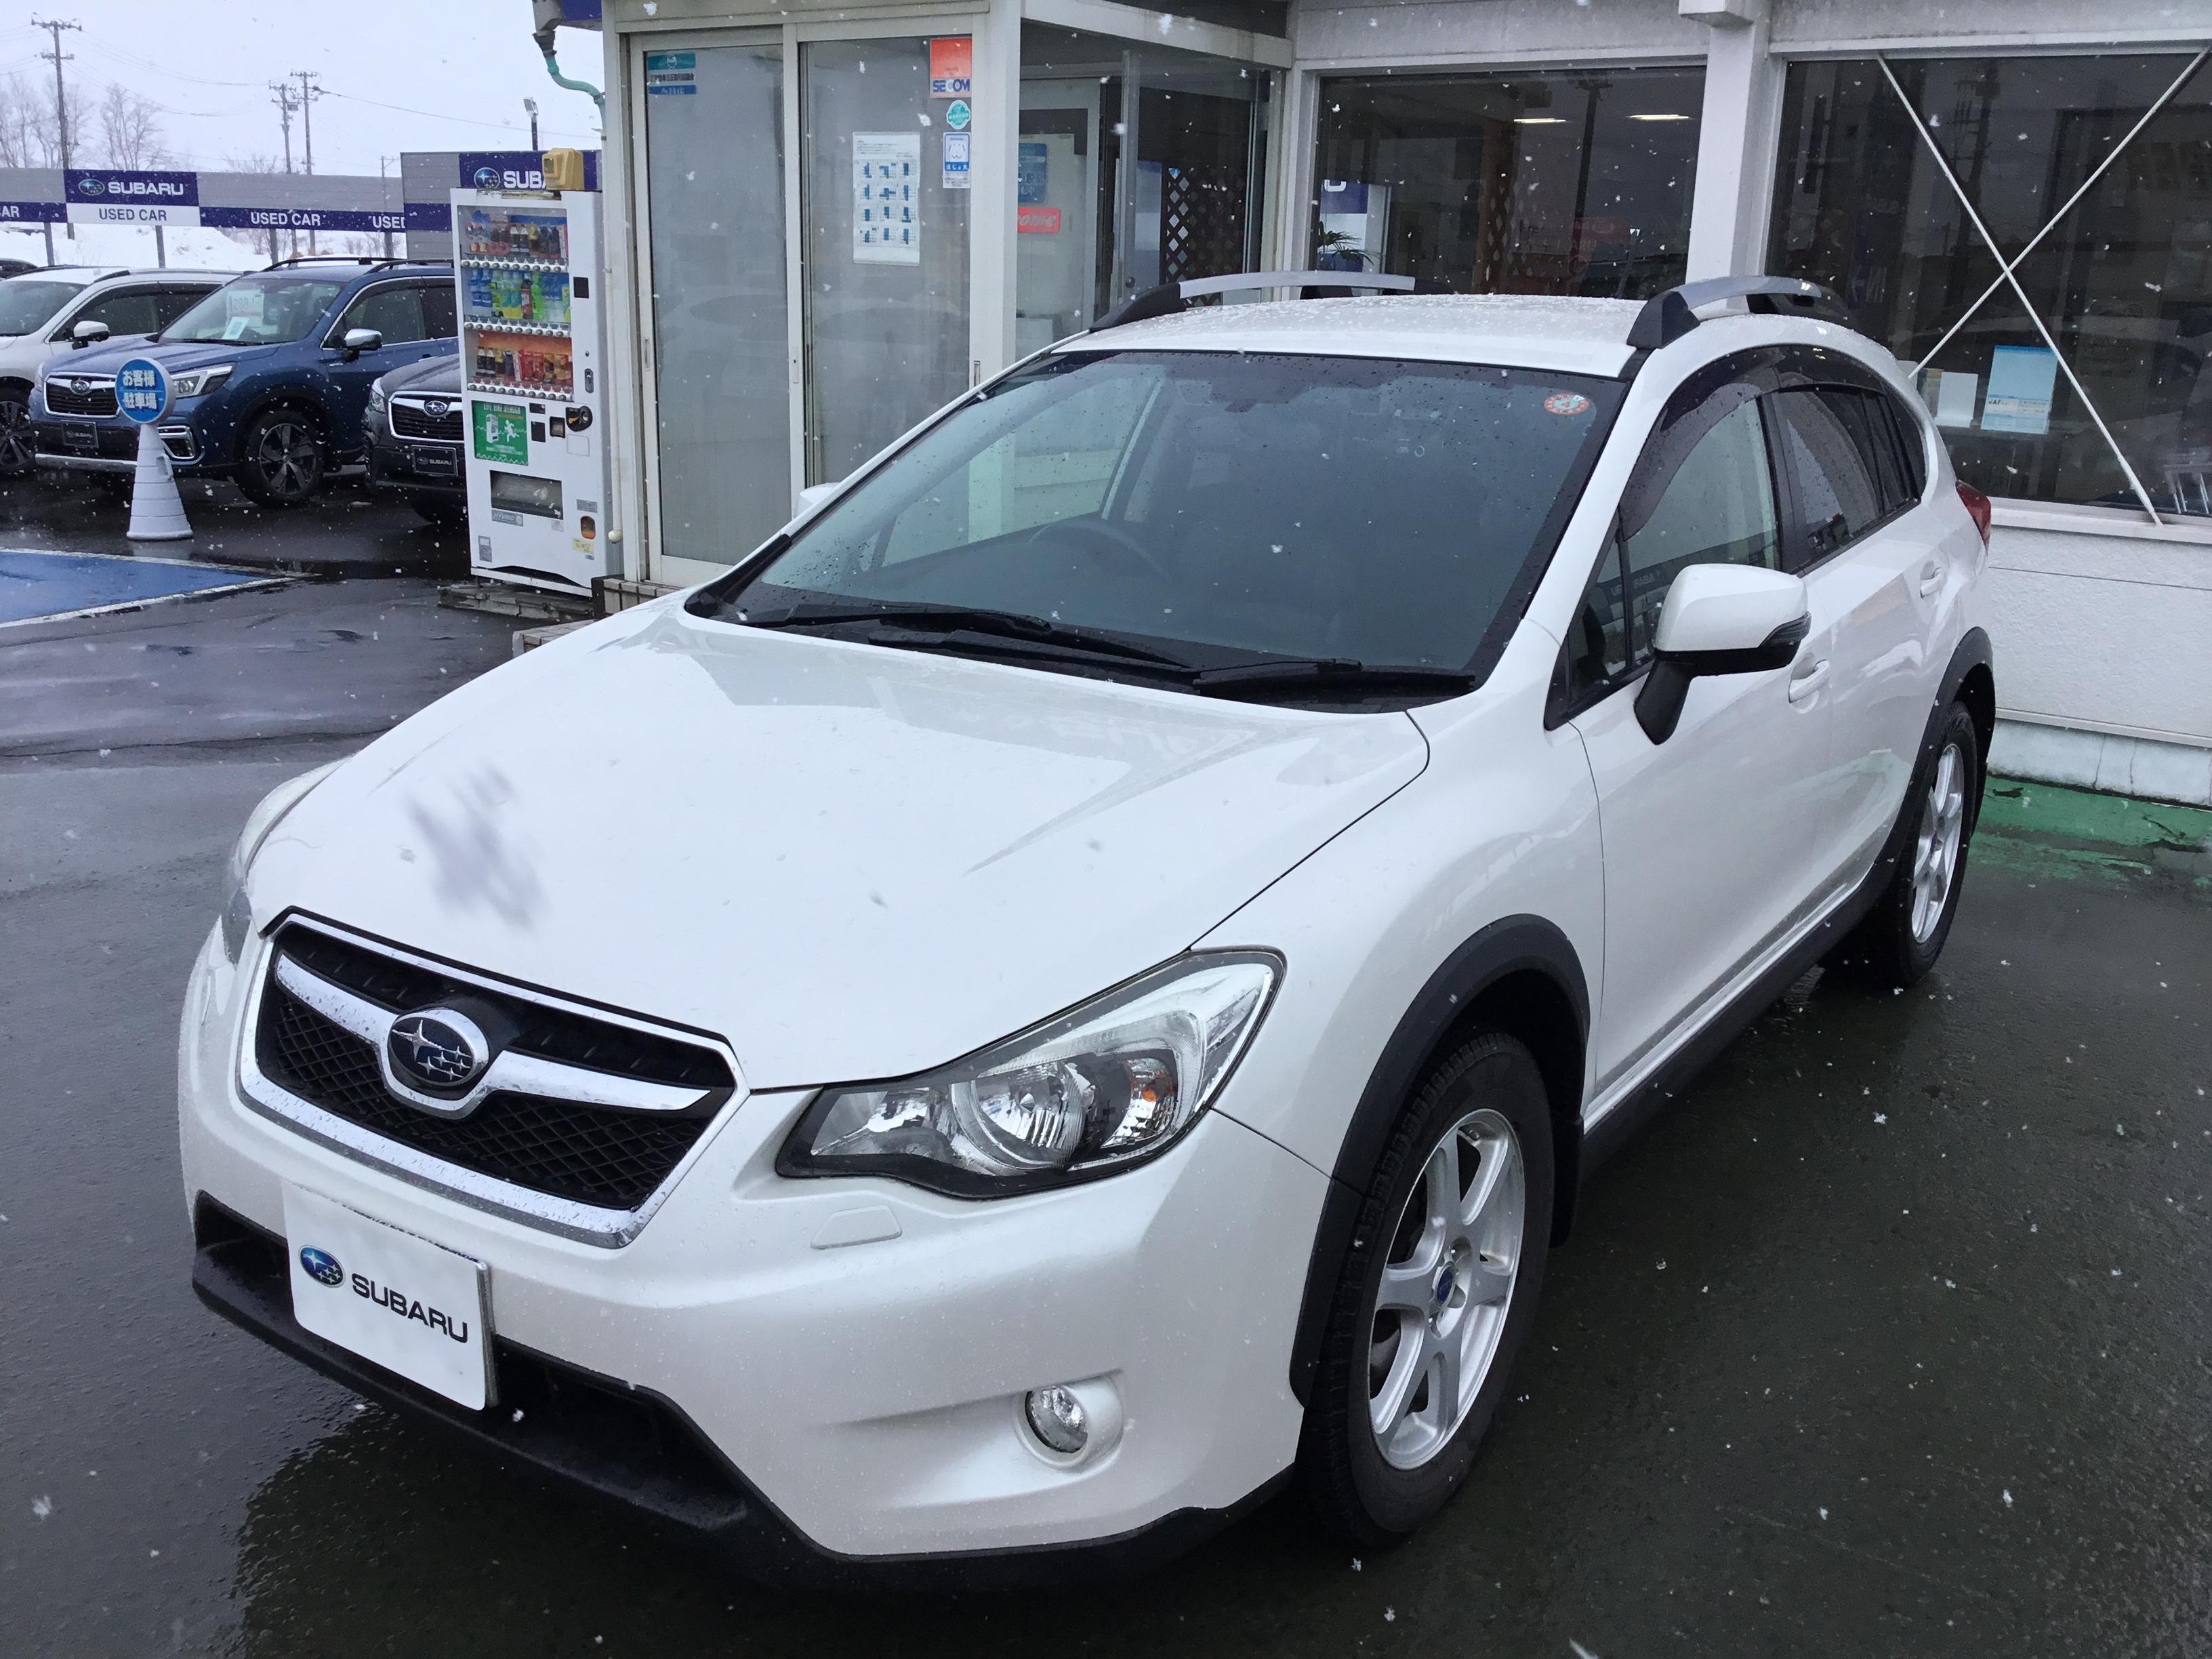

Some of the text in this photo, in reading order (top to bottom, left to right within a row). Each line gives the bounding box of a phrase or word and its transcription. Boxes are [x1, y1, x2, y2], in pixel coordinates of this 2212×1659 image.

[933, 79, 970, 92] SECOM
[504, 171, 546, 188] SUB
[108, 182, 184, 195] SUBARU
[0, 205, 20, 218] AR
[99, 208, 167, 221] USED CAR
[251, 212, 321, 226] USED CAR
[123, 370, 155, 387] お客様
[122, 392, 157, 409] 駐車場
[351, 1273, 468, 1344] SUBARU
